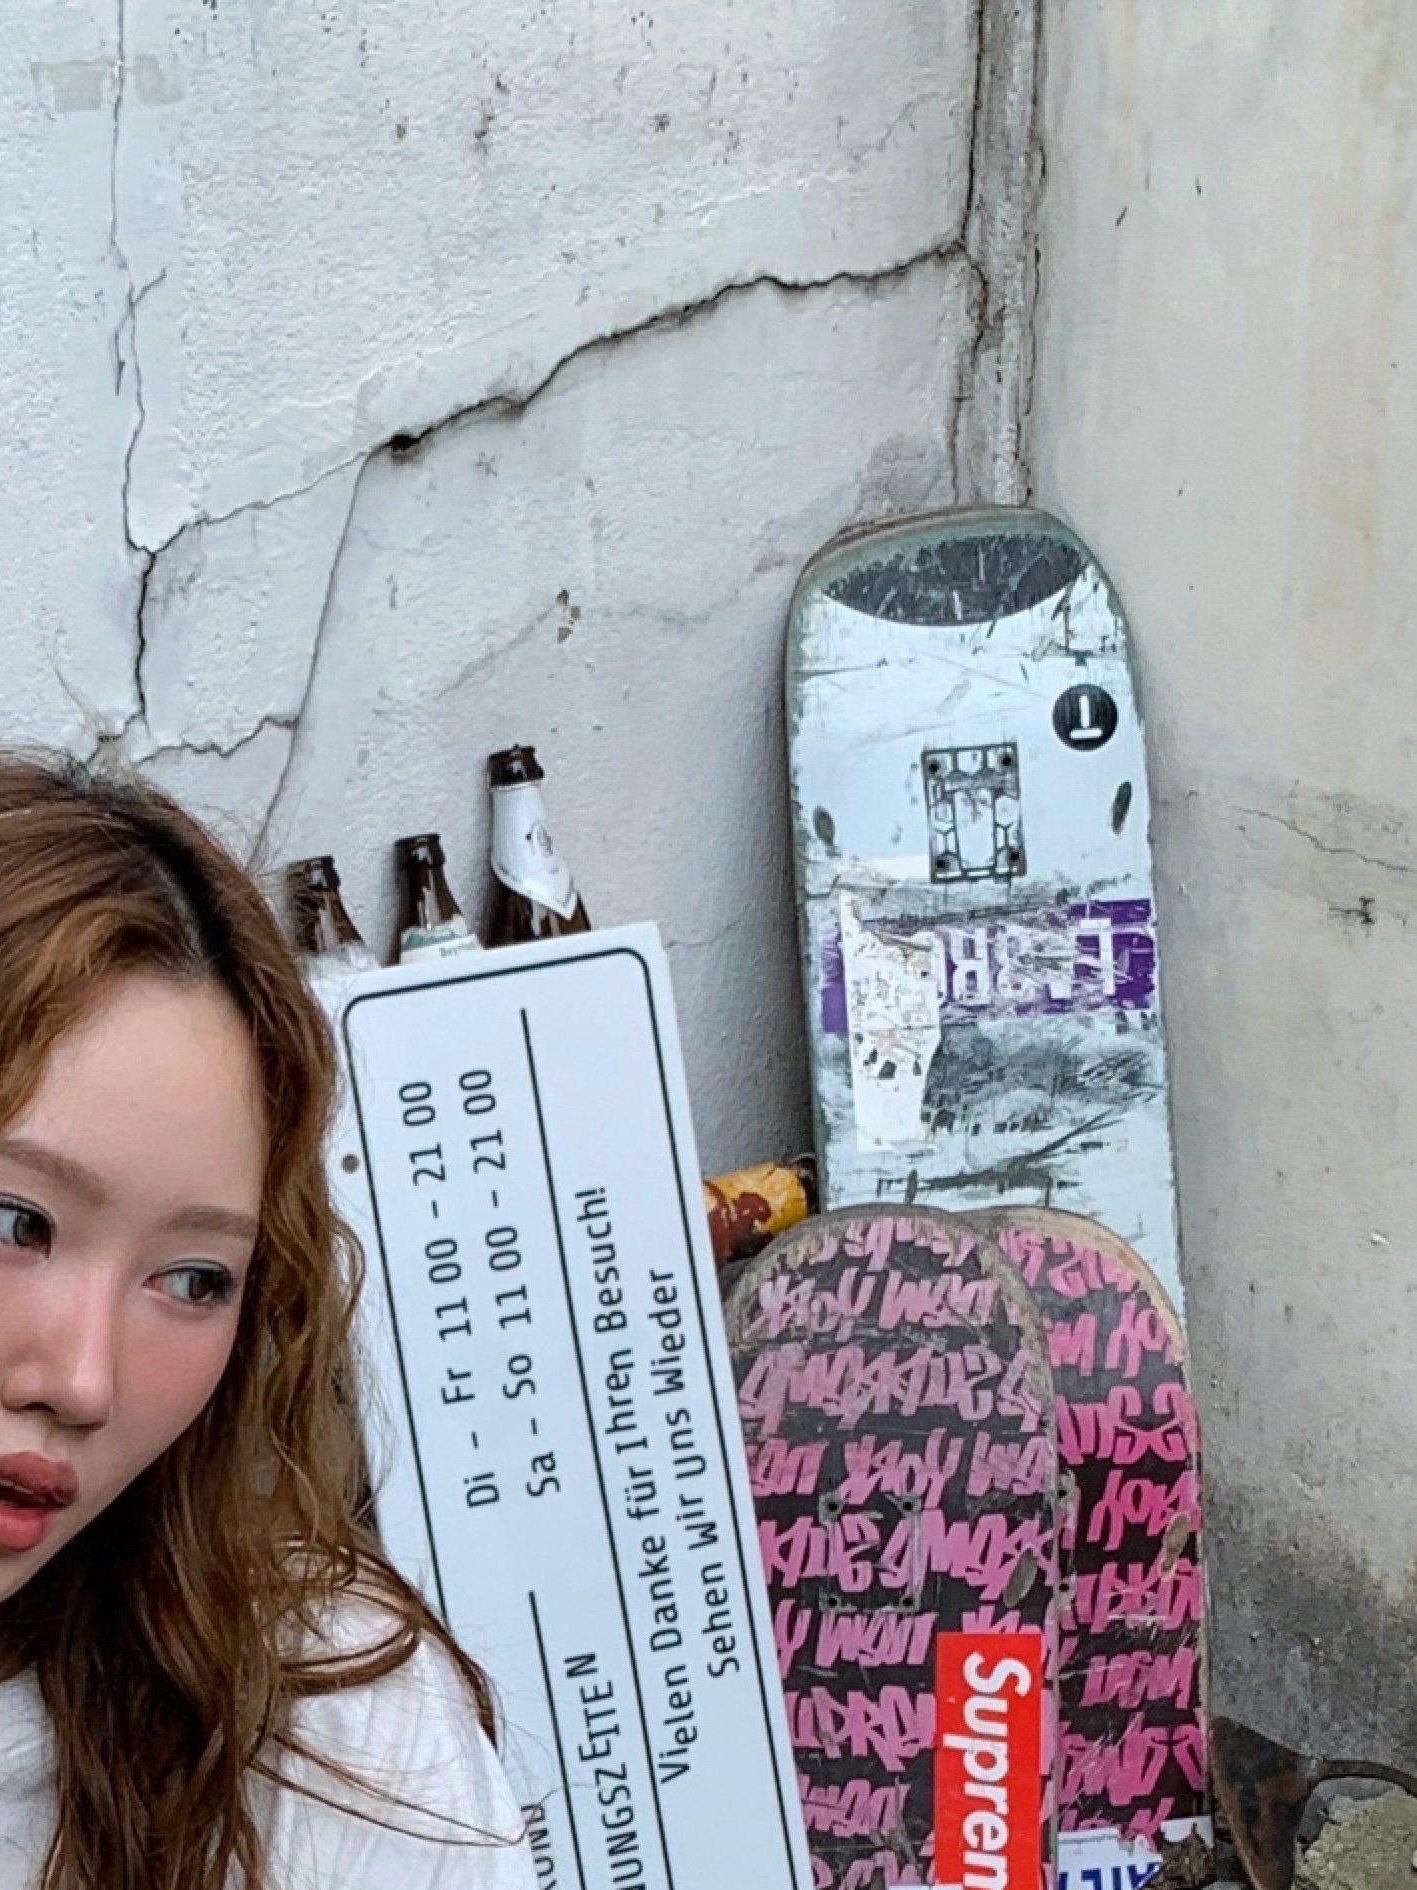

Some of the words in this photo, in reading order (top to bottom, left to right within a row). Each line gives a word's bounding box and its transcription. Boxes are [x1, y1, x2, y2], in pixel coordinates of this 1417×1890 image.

[398, 1081, 436, 1127] 00
[458, 1069, 496, 1115] 00
[408, 1142, 447, 1187] 21
[468, 1128, 507, 1174] 21
[425, 1237, 462, 1284] 00
[484, 1226, 521, 1272] 00
[574, 1187, 628, 1334] Besuch!
[434, 1296, 471, 1341] 11
[494, 1284, 532, 1330] 11
[647, 1268, 686, 1396] Wieder
[441, 1368, 475, 1404] Fr
[502, 1354, 536, 1400] So
[604, 1348, 648, 1455] Ihren
[666, 1408, 707, 1480] Uns
[463, 1471, 499, 1508] Di
[526, 1451, 561, 1498] Sa
[624, 1466, 659, 1520] für
[675, 1494, 719, 1550] Wir
[638, 1535, 682, 1652] Danke
[700, 1562, 740, 1678] Sehen
[657, 1664, 698, 1784] Vielen
